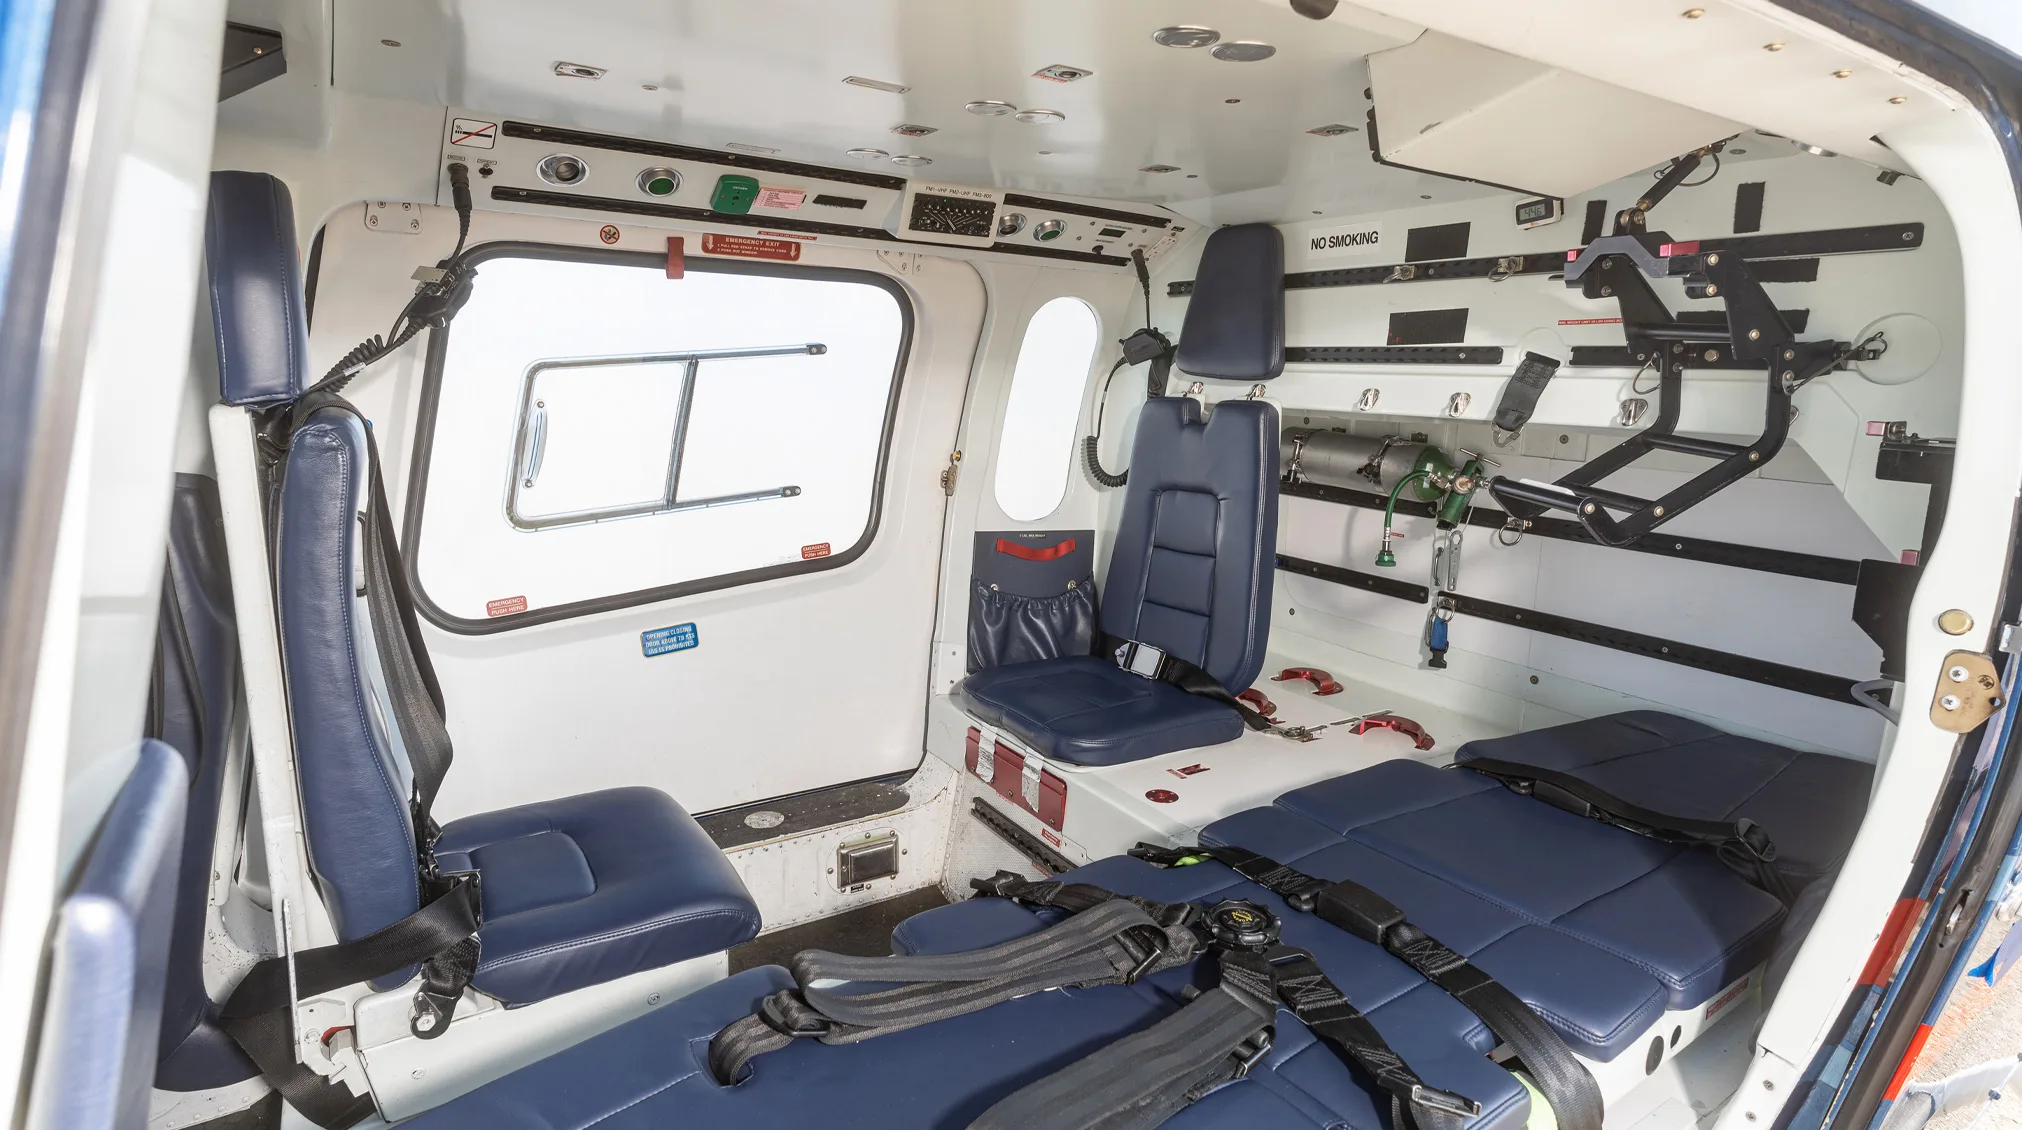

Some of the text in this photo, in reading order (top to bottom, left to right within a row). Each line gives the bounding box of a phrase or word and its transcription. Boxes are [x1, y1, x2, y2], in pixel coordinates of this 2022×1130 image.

[726, 237, 763, 246] EMERGENCY
[1311, 230, 1379, 250] NO SMOKING
[489, 597, 524, 608] EMERGENCY
